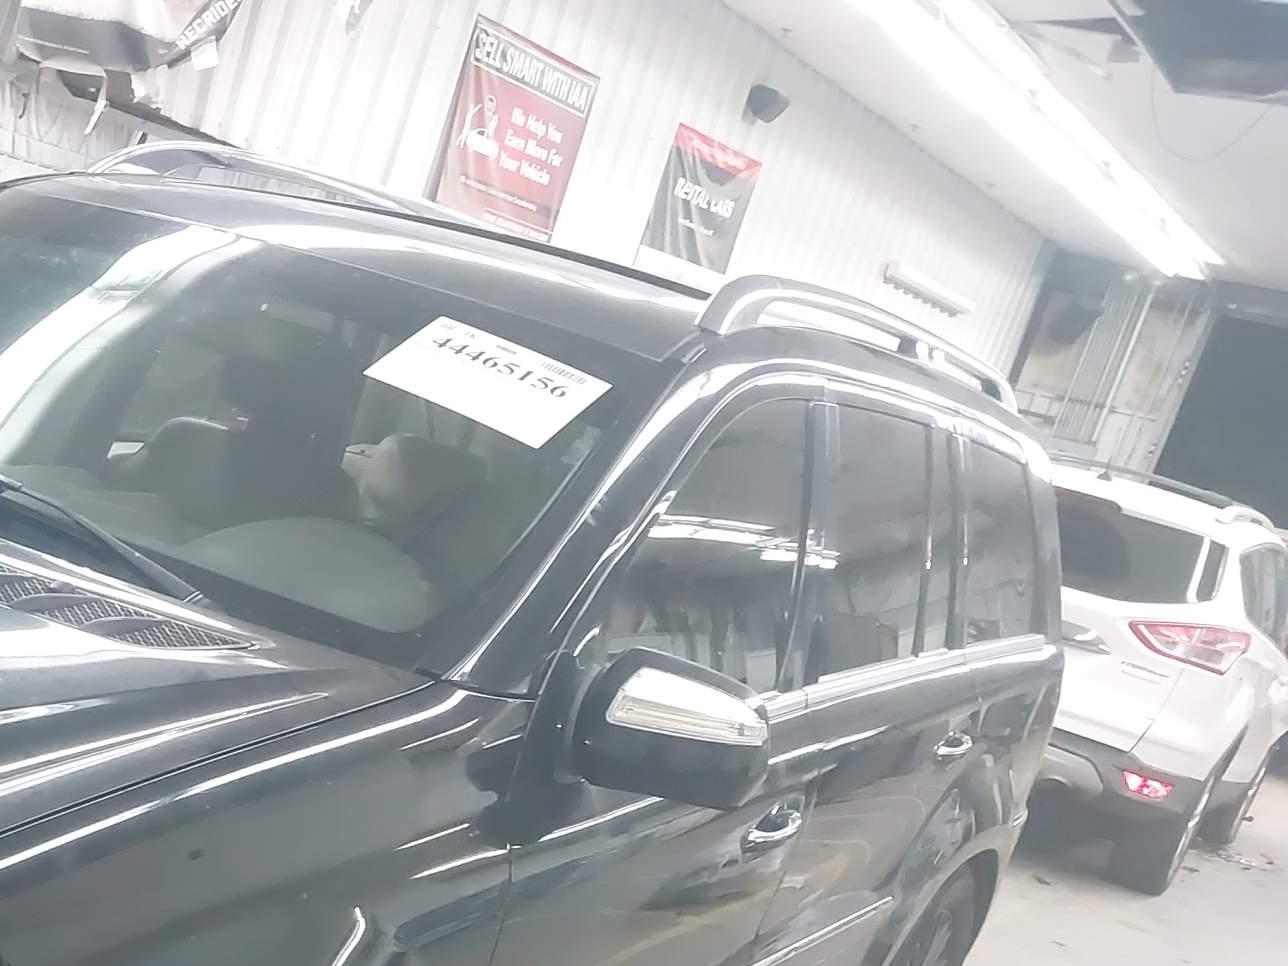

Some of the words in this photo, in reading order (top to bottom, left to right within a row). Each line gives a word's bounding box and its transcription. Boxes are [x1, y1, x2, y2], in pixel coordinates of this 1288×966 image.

[475, 33, 503, 68] SELL
[503, 46, 545, 87] SMART
[542, 66, 570, 101] WITH
[567, 79, 589, 111] IAA
[511, 106, 526, 127] We
[526, 114, 547, 139] Help
[547, 123, 563, 145] You
[499, 149, 521, 173] Your
[520, 159, 550, 186] Vehicle
[504, 128, 525, 152] Earn
[524, 138, 549, 161] More
[548, 148, 563, 168] For
[673, 177, 709, 210] RENTAL
[432, 337, 569, 398] 44465156
